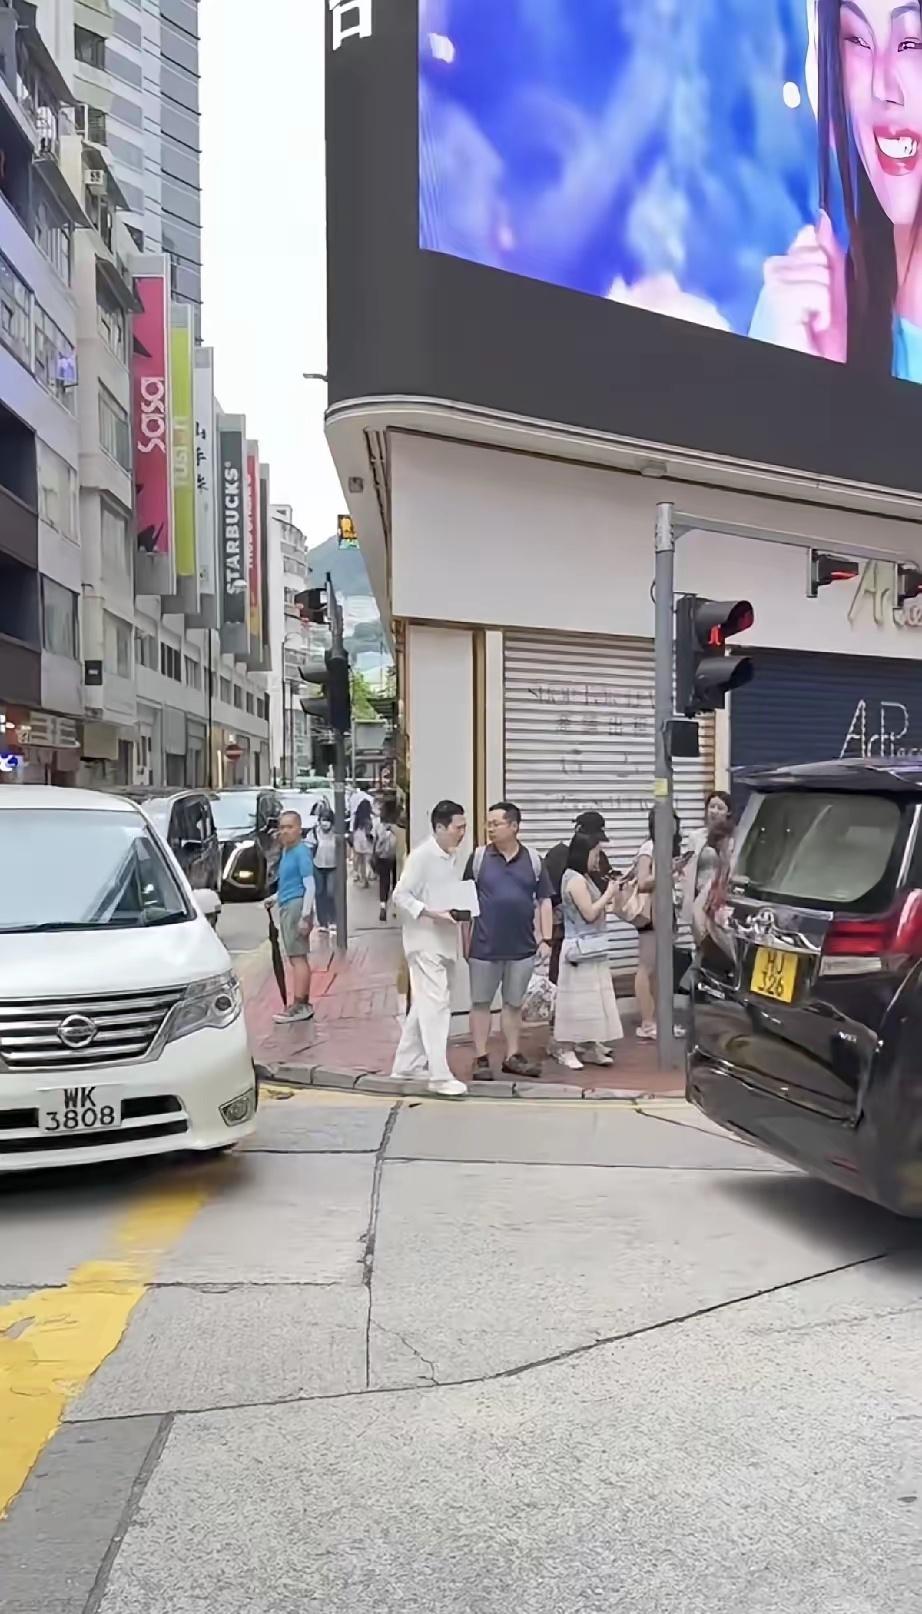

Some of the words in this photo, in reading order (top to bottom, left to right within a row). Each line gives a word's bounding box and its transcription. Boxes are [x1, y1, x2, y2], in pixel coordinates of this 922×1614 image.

[225, 467, 243, 595] STARBUCKS
[767, 950, 786, 975] HJ
[64, 1086, 97, 1109] WK
[45, 1105, 116, 1132] 3808
